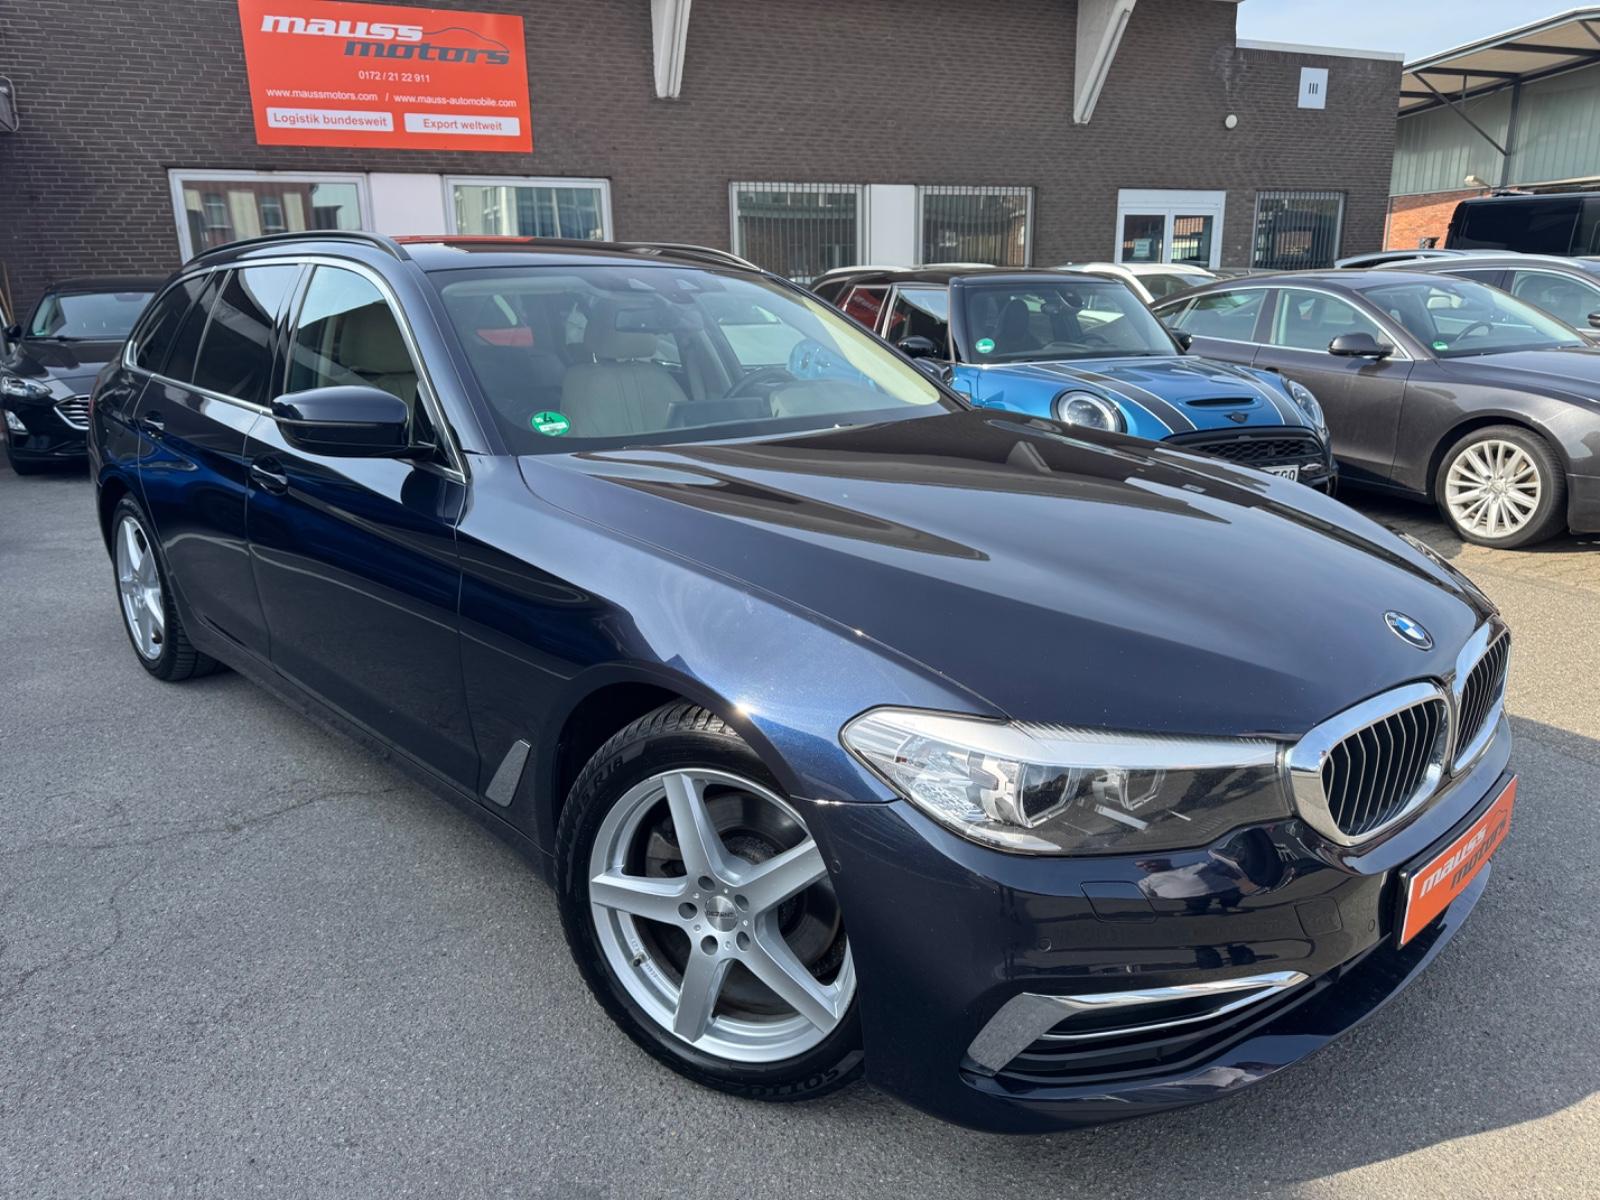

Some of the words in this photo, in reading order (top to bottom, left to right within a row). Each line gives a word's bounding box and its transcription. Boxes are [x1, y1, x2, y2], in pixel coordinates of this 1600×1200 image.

[261, 15, 423, 42] mauss
[344, 41, 509, 65] motors
[358, 70, 380, 80] 0172
[389, 71, 398, 81] 21
[401, 73, 412, 82] 22
[414, 74, 430, 83] 911
[266, 88, 378, 101] www.maussmotors.com
[393, 94, 517, 107] www.mauss-automobile.com
[273, 112, 320, 125] Logistik
[322, 114, 387, 127] bundesweit
[423, 118, 458, 130] Export
[461, 120, 502, 131] weltweit
[1419, 823, 1487, 898] mauss
